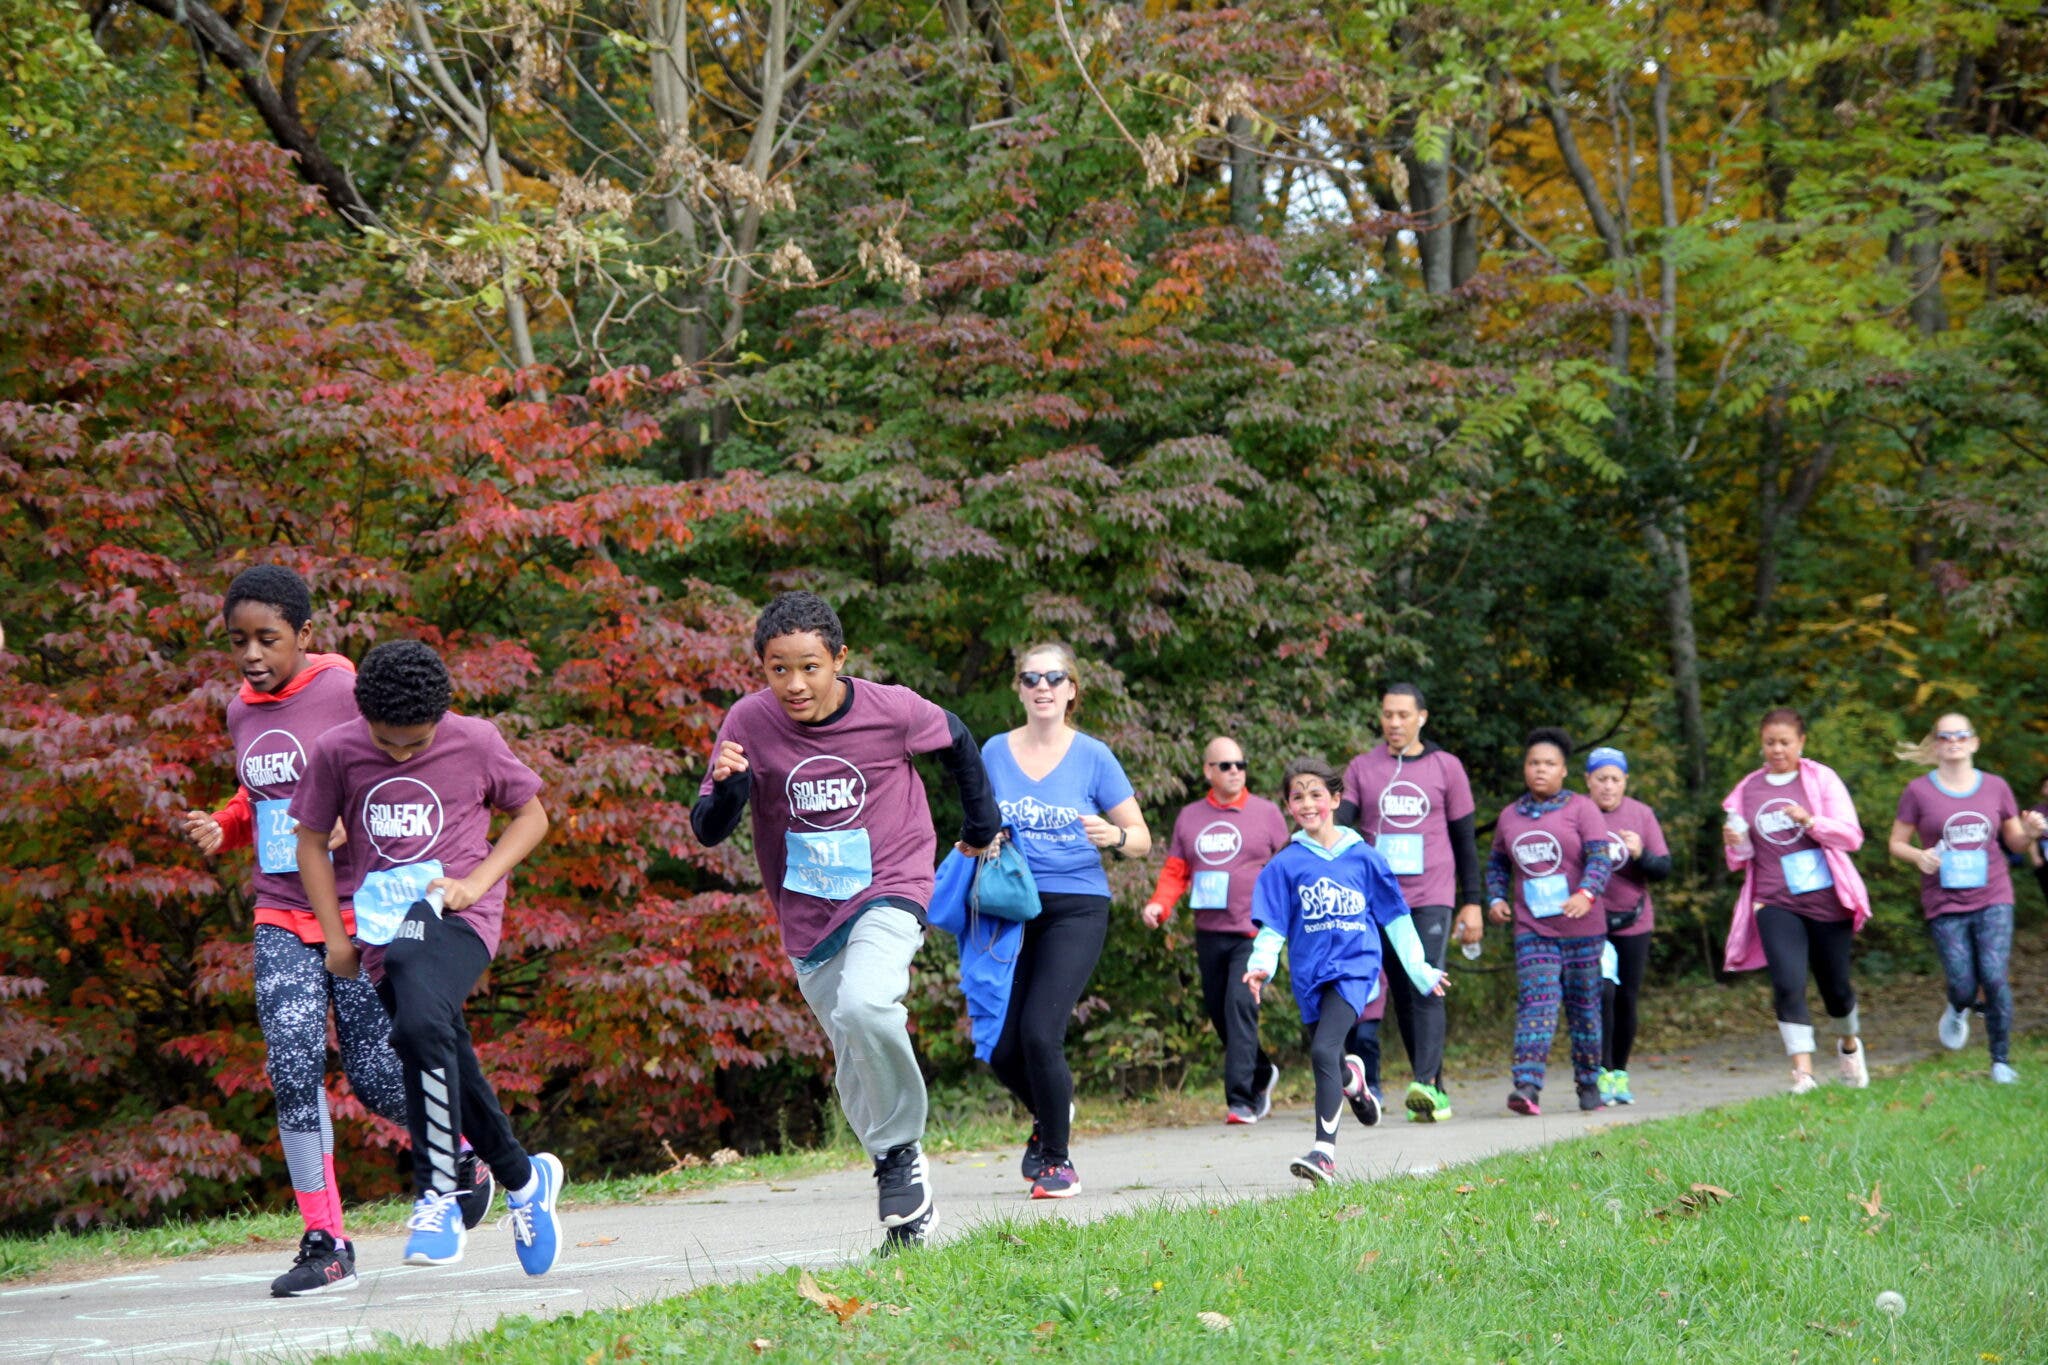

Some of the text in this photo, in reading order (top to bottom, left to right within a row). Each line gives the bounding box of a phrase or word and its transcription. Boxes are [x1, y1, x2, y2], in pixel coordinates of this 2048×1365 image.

[246, 751, 301, 783] SOLE 5K
[247, 768, 277, 787] TRAIN
[793, 778, 859, 810] SOLE 5K
[794, 793, 828, 812] TRAIN
[369, 804, 434, 837] SOLE 5K
[370, 819, 402, 837] TRAIN
